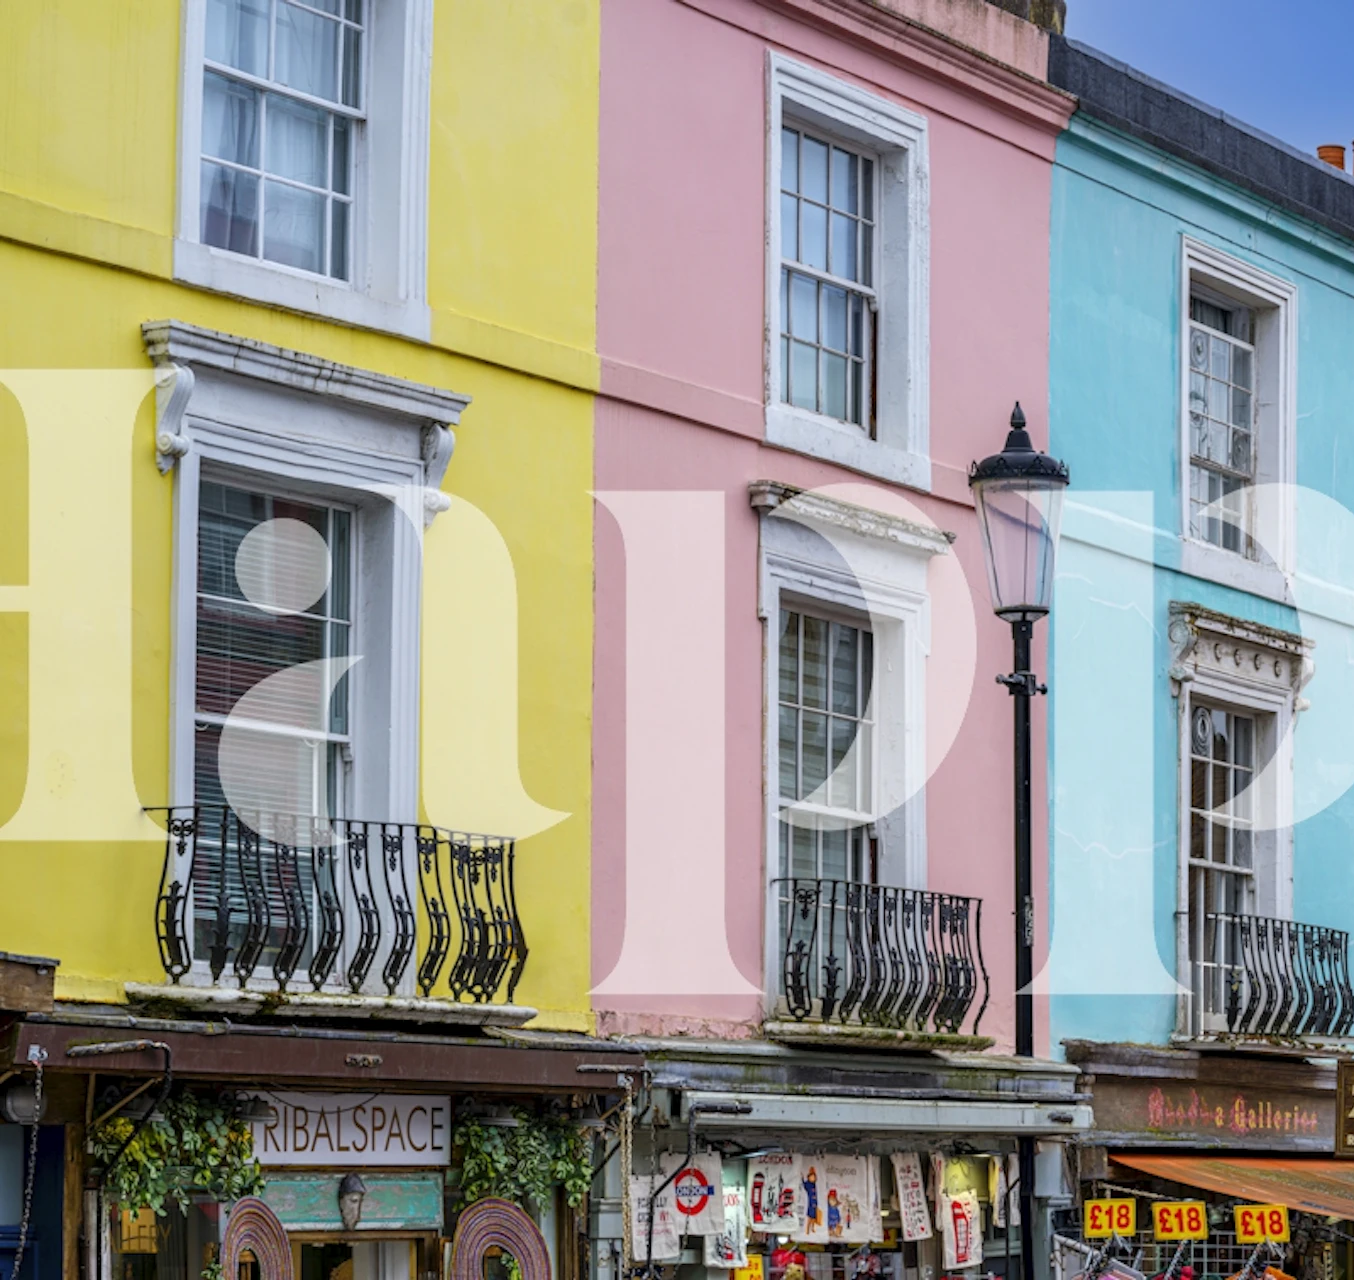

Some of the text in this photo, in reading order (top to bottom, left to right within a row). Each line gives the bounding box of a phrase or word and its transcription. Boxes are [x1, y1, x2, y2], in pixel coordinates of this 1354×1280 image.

[1089, 1204, 1131, 1230] £18
[1158, 1206, 1202, 1233] £18
[1241, 1210, 1284, 1236] £18
